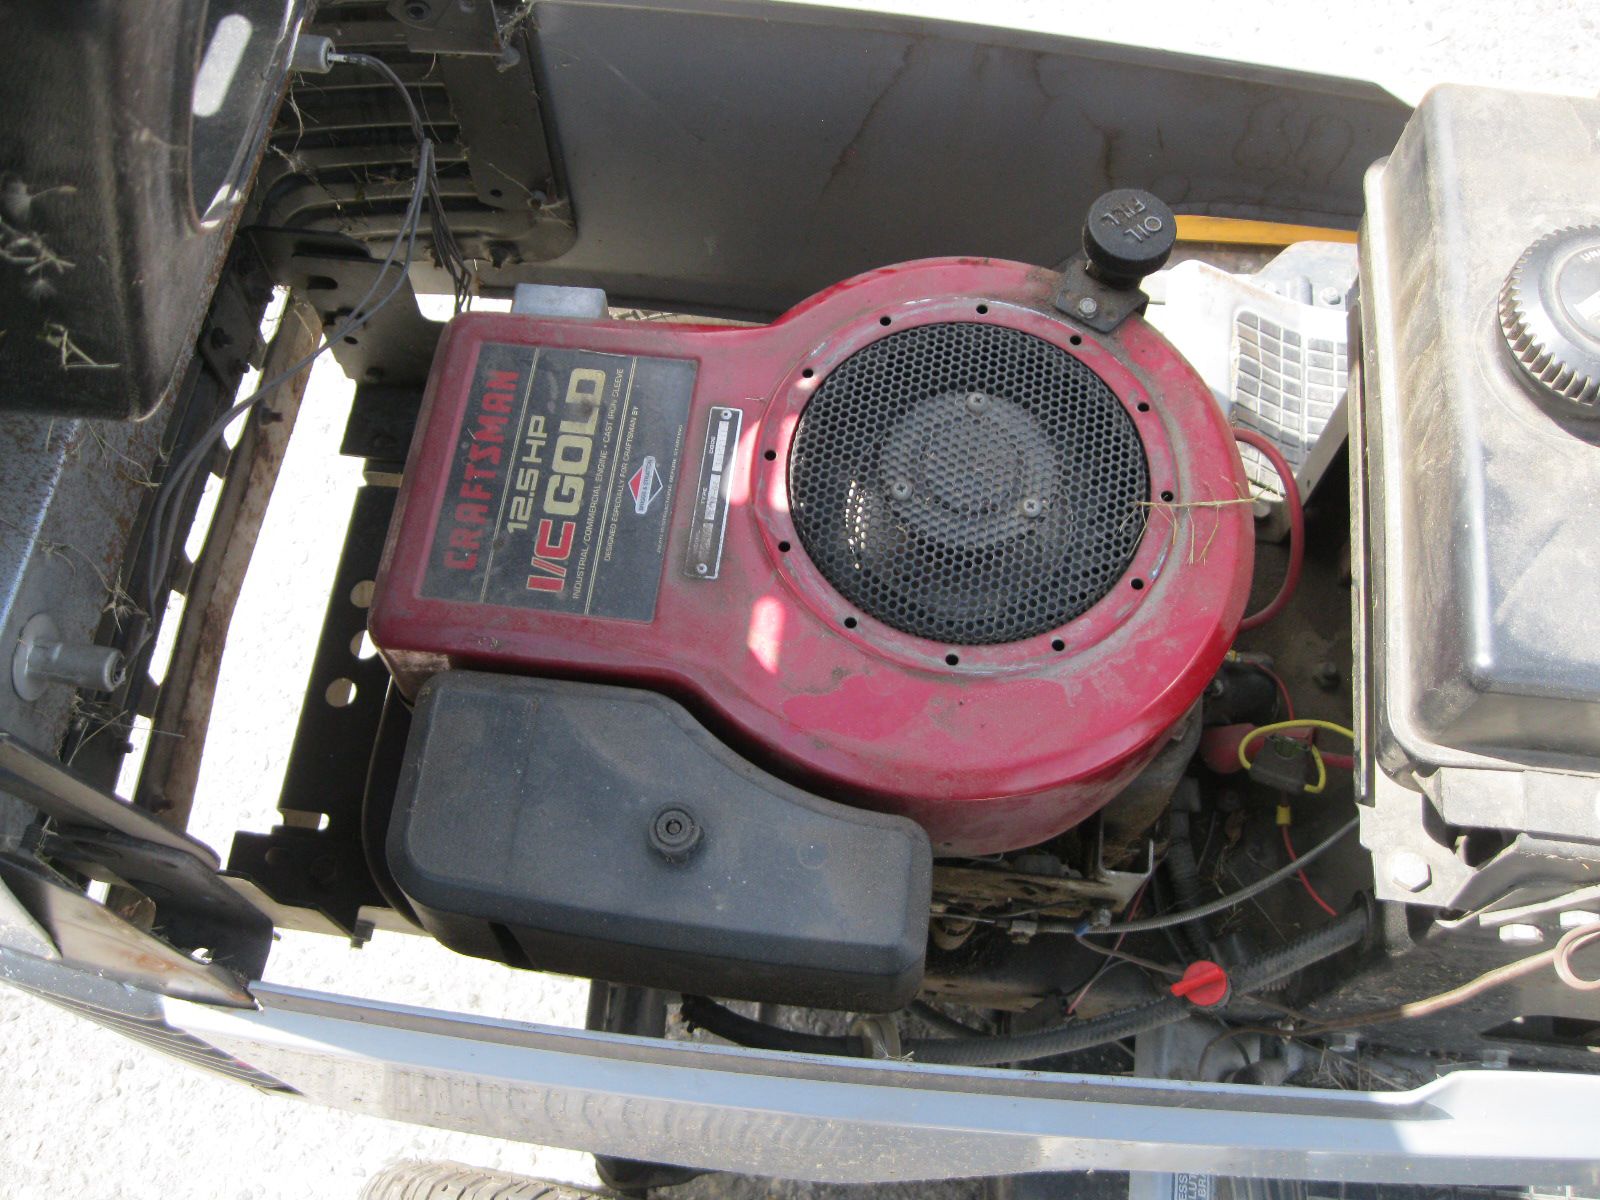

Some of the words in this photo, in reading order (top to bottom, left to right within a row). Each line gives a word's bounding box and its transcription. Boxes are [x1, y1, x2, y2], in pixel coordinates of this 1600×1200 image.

[1123, 215, 1162, 242] OIL
[611, 368, 623, 397] SLEEVE
[608, 399, 617, 419] IRON
[631, 405, 638, 415] BY
[521, 414, 551, 463] HP
[542, 367, 608, 516] GOLD
[603, 421, 613, 442] CAST
[623, 416, 637, 461] CRAFTSMAN
[443, 369, 520, 571] CRAFTSMAN
[595, 449, 608, 481] ENGINE
[620, 462, 628, 477] FOR
[506, 467, 540, 535] 12.5
[612, 479, 625, 521] ESPECIALLY
[525, 518, 576, 592] I/C
[572, 484, 601, 599] INDUSTRIAL/COMMERCIAL
[604, 522, 617, 561] DESIGNED
